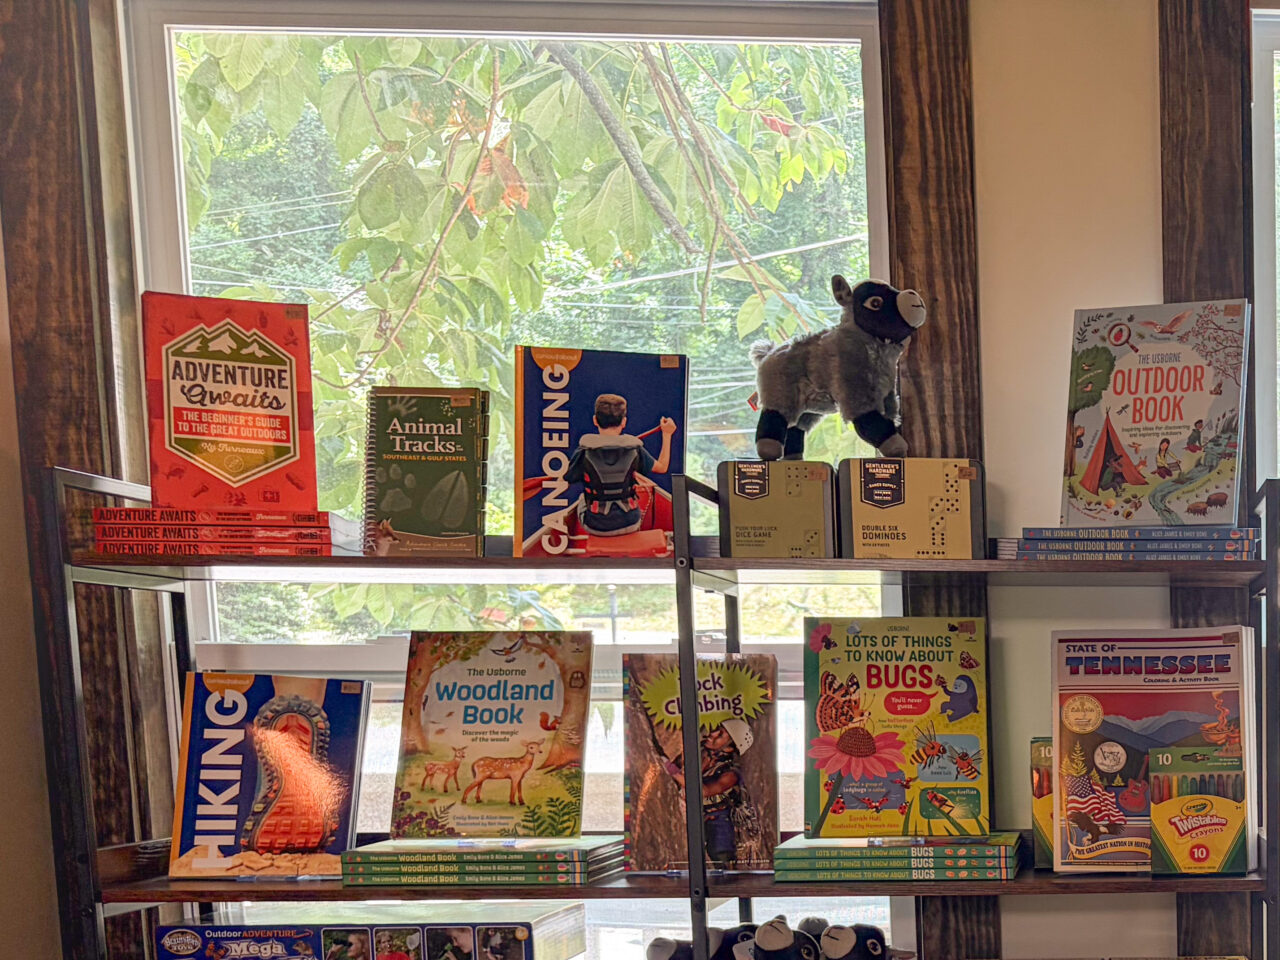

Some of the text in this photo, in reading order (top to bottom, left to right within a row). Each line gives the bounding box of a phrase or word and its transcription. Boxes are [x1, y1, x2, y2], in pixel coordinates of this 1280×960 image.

[1138, 352, 1182, 364] THE USBORNE
[171, 359, 289, 390] ADVENTURE
[1112, 364, 1205, 396] OUTDOOR
[180, 383, 286, 411] Awaits
[1132, 395, 1184, 424] BOOK
[182, 410, 282, 429] THE BEGINNER'S GUIDE
[386, 417, 463, 435] Animal
[178, 421, 288, 440] TO THE GREAT OUTDOORS
[390, 435, 456, 453] Tracks
[382, 454, 420, 462] SOUTHEAST
[541, 363, 570, 555] CANOEING
[100, 509, 197, 523] ADVENTURE AWAITS
[101, 526, 199, 539] ADVENTURE AWAITS
[862, 532, 907, 540] DOMINOES
[1078, 529, 1129, 538] OUTDOOR BOOK
[102, 543, 199, 555] ADVENTURE AWAITS
[1074, 541, 1124, 551] OUTDOOR BOOK
[846, 635, 952, 648] LOTS OF THINGS
[1066, 643, 1117, 653] STATE OF
[844, 650, 954, 662] TO KNOW ABOUT
[1065, 653, 1231, 675] TENNESSEE
[467, 668, 527, 676] The Usborne
[866, 663, 933, 689] BUGS
[435, 679, 555, 701] Woodland
[665, 694, 744, 716] Clbing
[462, 703, 524, 724] Book
[1157, 753, 1172, 765] 10
[191, 689, 248, 869] HIKING
[1170, 815, 1227, 834] Twistables
[1189, 827, 1224, 839] Crayons
[398, 853, 457, 862] Woodland Book
[911, 847, 934, 857] BUGS
[1192, 848, 1207, 858] 10
[401, 863, 459, 872] Woodland Book
[911, 858, 934, 868] BUGS
[401, 875, 459, 883] Woodland Book
[912, 870, 935, 879] BUGS
[205, 930, 296, 938] Outdoor ADVENTURE
[229, 940, 284, 957] Mega
